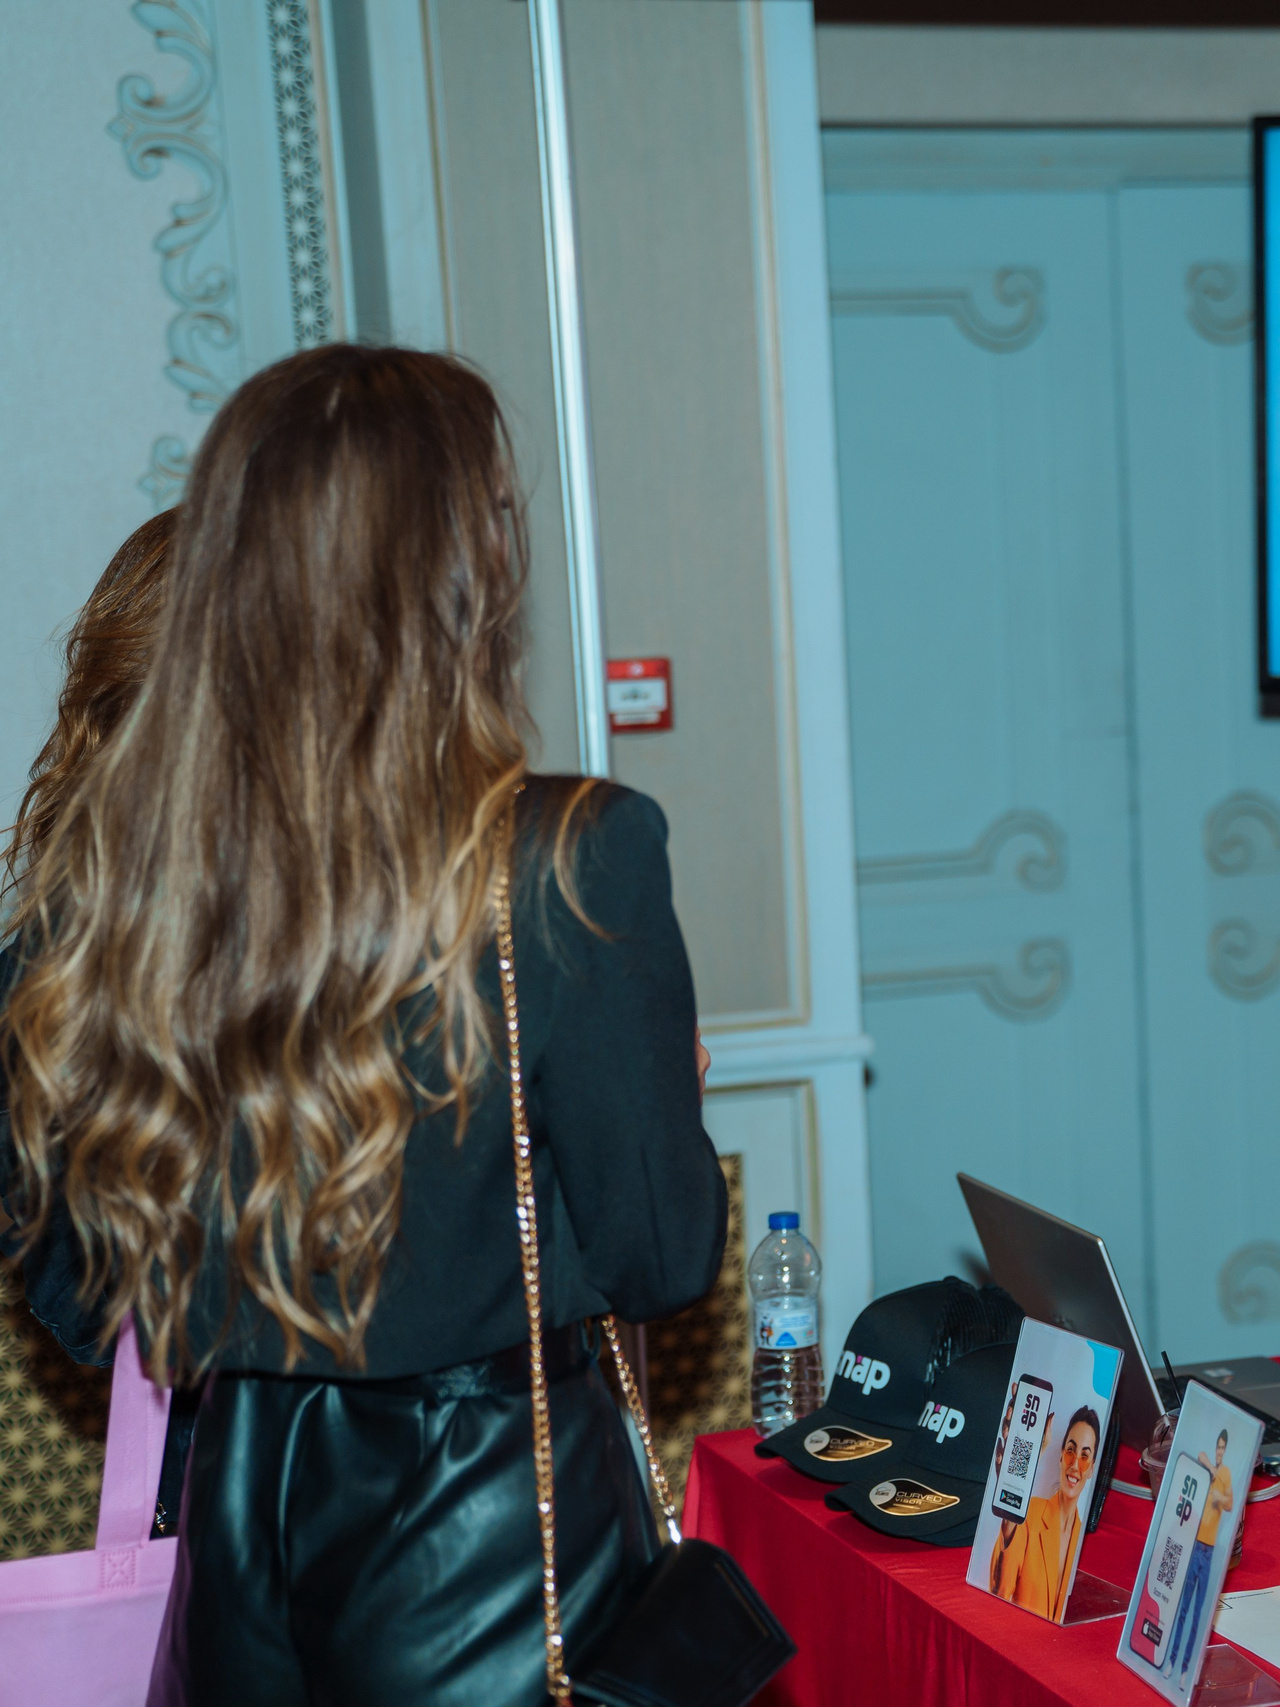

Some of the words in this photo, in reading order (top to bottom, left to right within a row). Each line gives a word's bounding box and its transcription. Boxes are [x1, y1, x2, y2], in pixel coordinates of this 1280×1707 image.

[837, 1350, 891, 1396] nap
[895, 1497, 922, 1505] VISOR
[896, 1491, 943, 1503] CURVED
